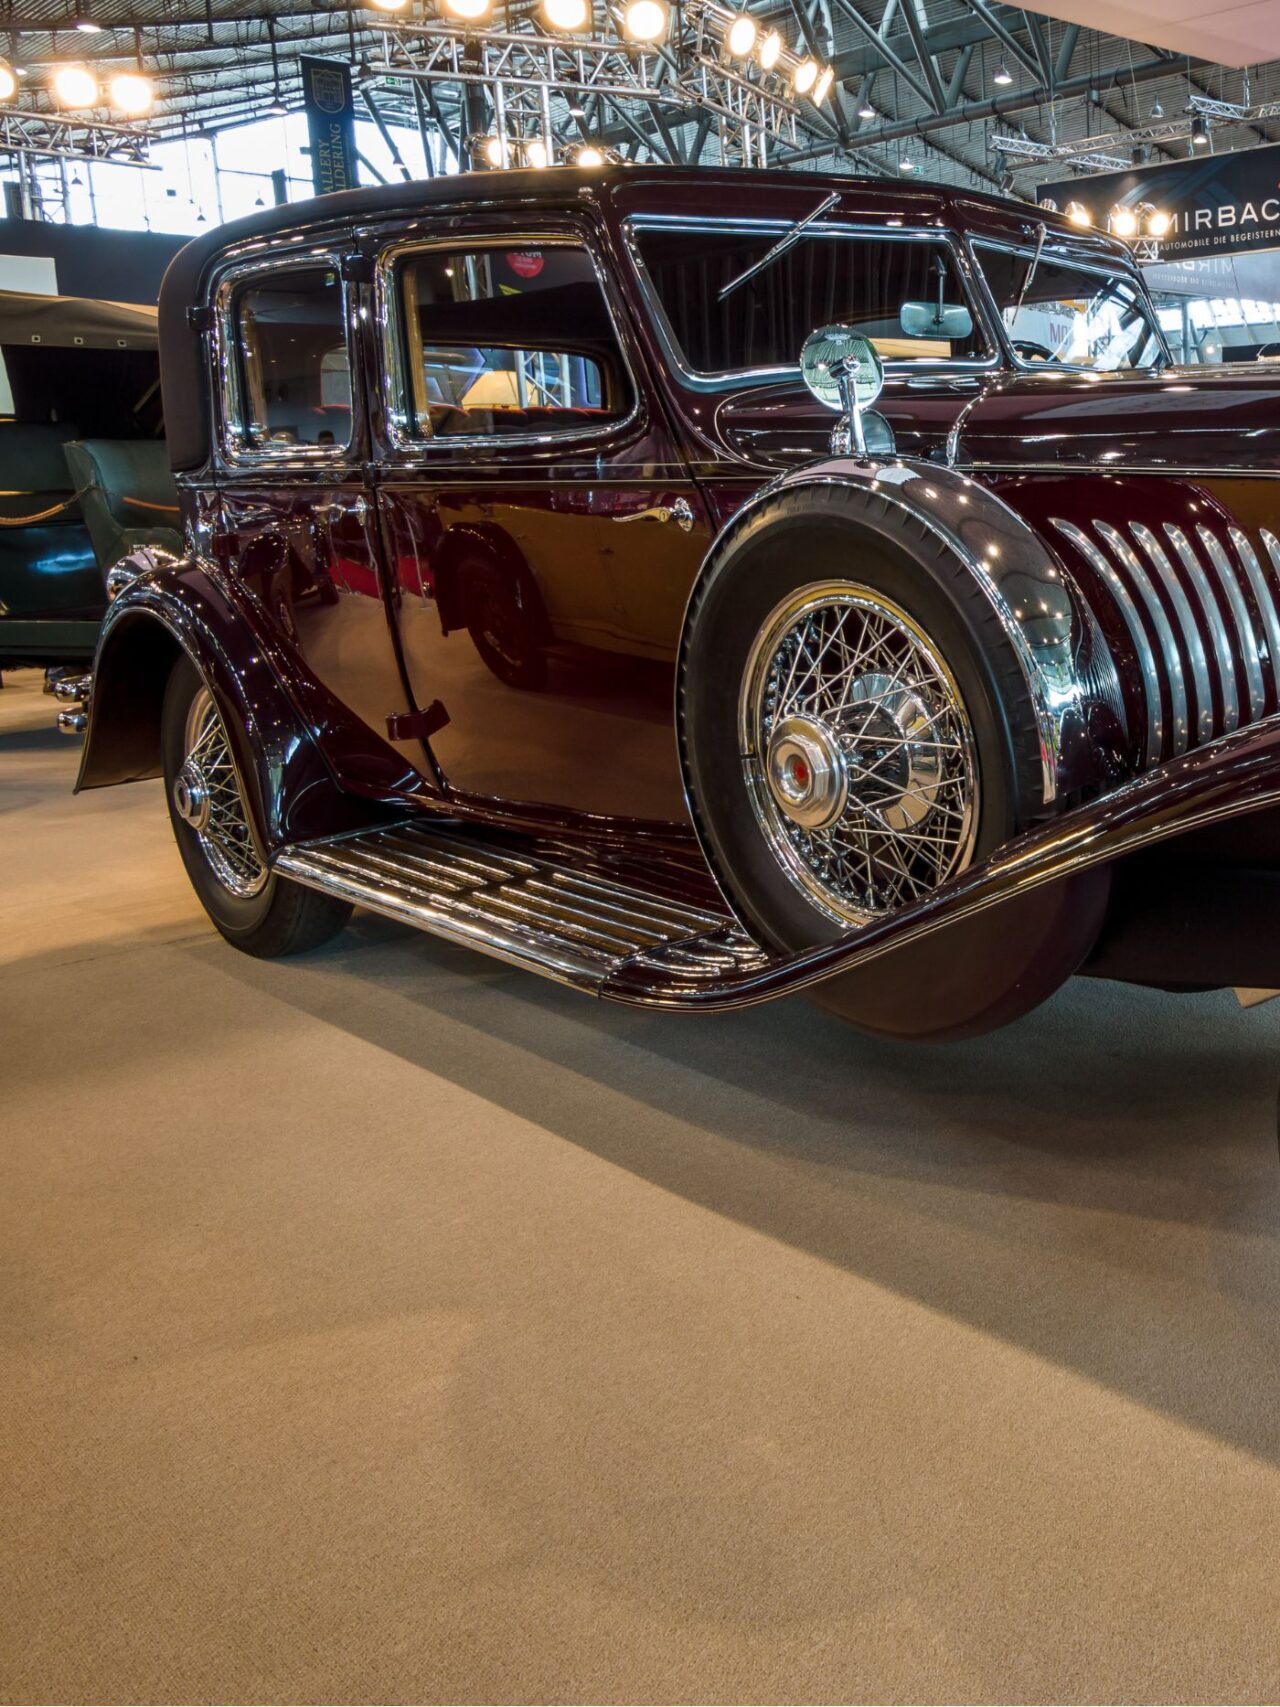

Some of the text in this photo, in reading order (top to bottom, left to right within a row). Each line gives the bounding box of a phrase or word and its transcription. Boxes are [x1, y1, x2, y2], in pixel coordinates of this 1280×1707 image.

[318, 137, 332, 193] ALLERY
[329, 122, 347, 191] LDERING
[1159, 237, 1211, 251] AUTOMOBILE
[1213, 235, 1227, 246] DIE
